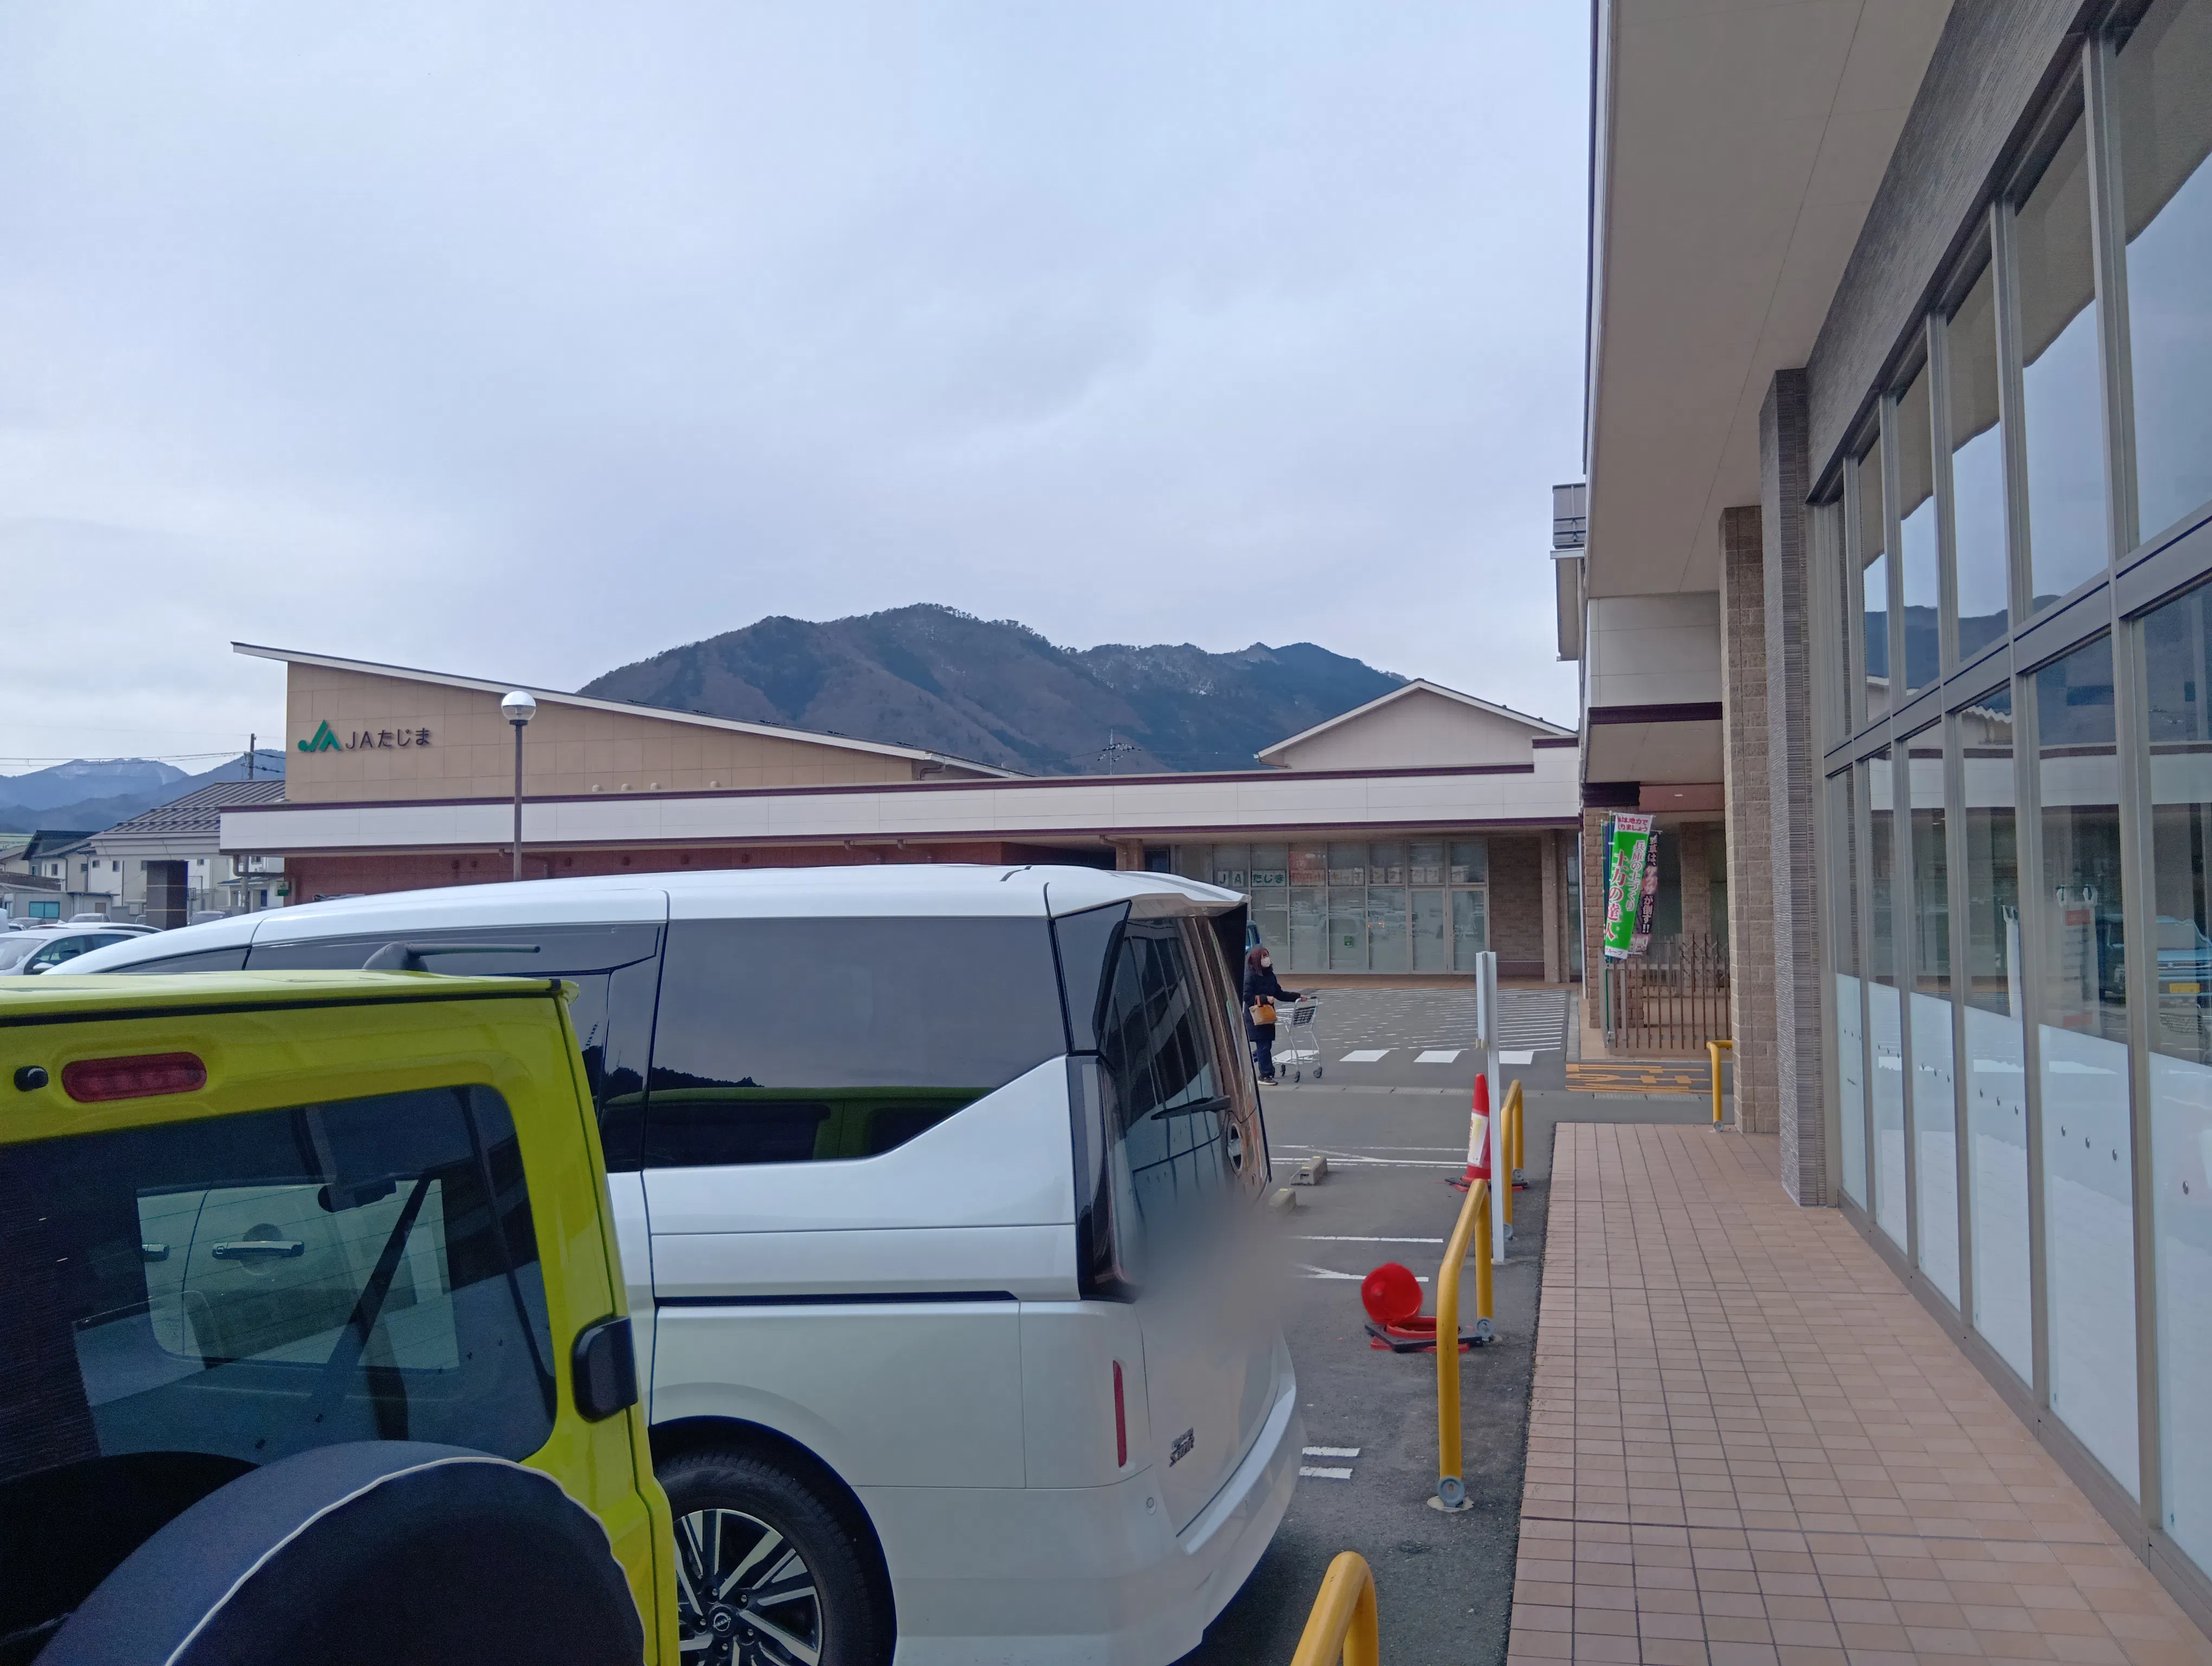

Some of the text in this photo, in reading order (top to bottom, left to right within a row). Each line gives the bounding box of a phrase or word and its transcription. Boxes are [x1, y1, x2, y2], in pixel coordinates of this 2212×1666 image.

[345, 727, 430, 749] JAたじま
[1626, 841, 1645, 911] 兵庫の土づくり
